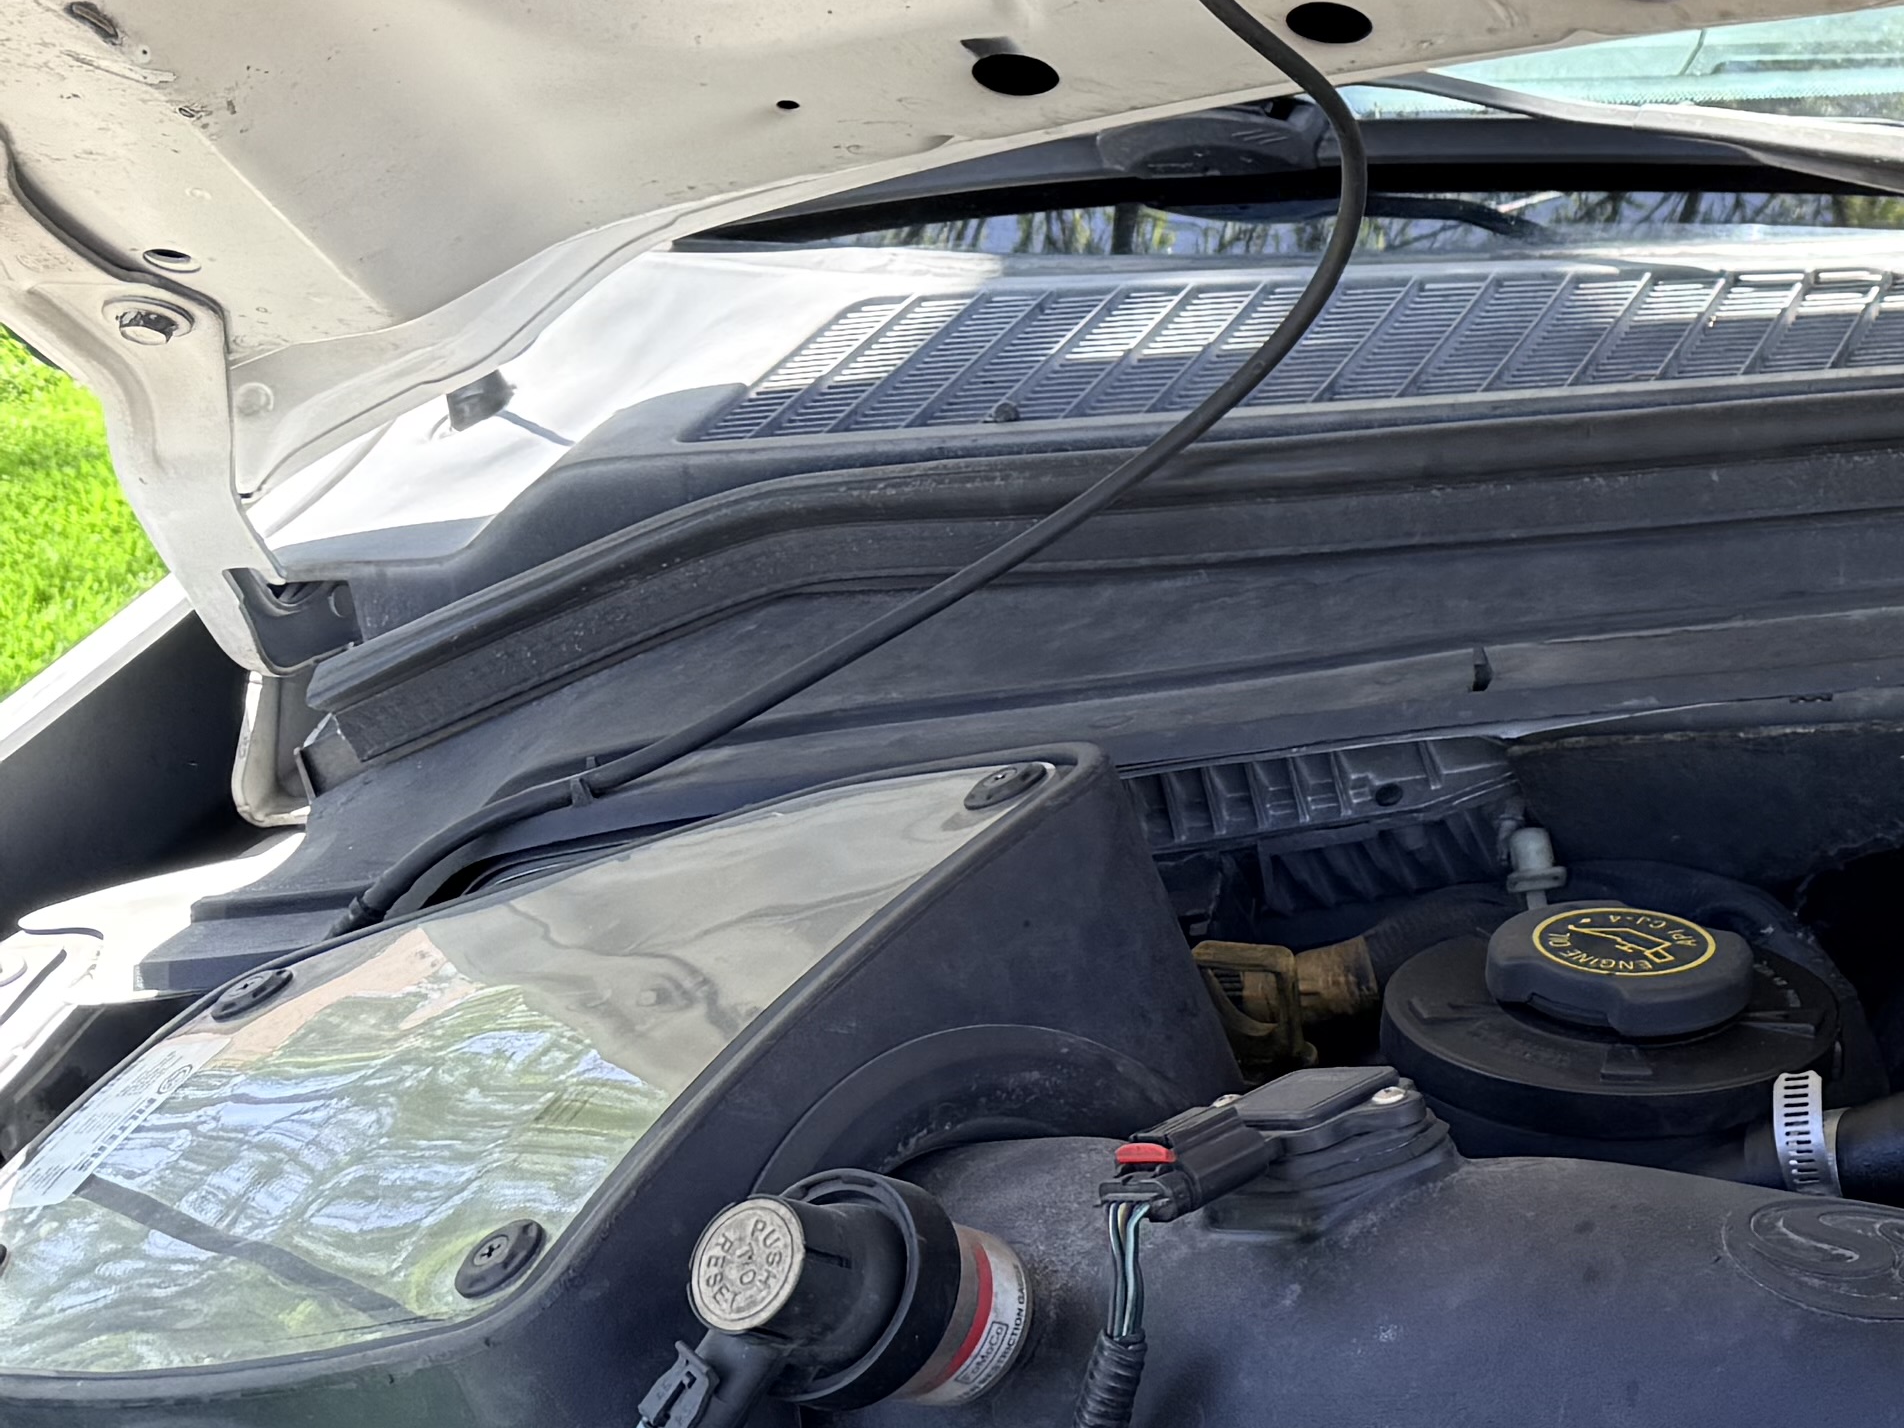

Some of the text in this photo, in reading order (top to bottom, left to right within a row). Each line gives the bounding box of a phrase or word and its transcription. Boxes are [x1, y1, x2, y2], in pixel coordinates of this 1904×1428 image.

[1548, 933, 1653, 970] ENGINE OIL
[1668, 929, 1697, 947] API
[77, 1097, 157, 1172] FILTERS
[705, 1232, 742, 1311] RESET
[737, 1241, 757, 1286] TO
[751, 1218, 783, 1291] PUSH
[963, 1325, 1004, 1383] FoMoCo
